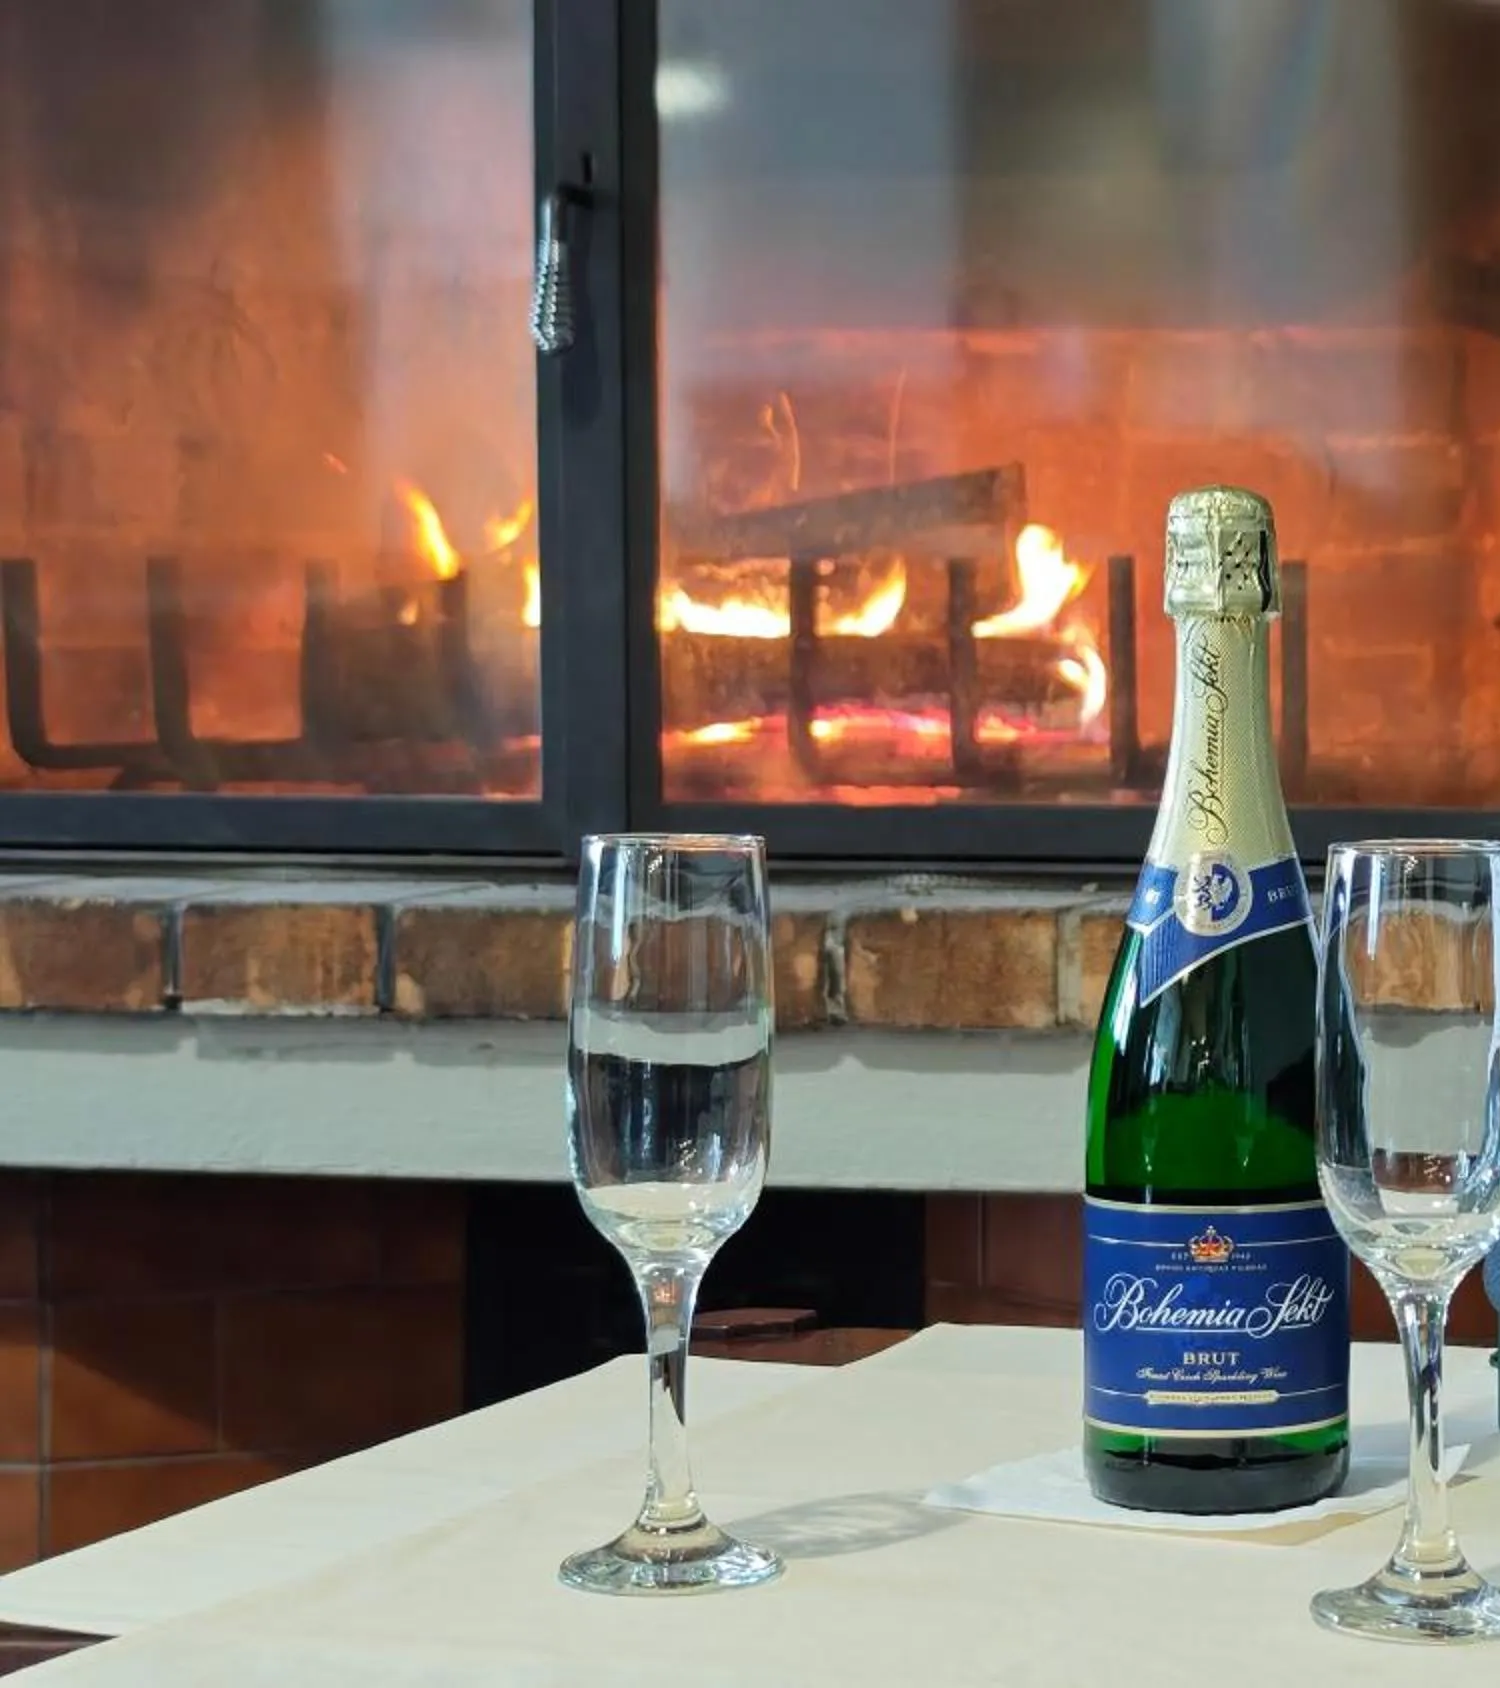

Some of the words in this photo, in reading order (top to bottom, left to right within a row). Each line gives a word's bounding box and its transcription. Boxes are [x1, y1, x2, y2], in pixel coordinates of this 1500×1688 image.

[1188, 634, 1229, 714] Sekt
[1184, 702, 1230, 847] Bohemia
[1093, 1272, 1247, 1332] Bohemia
[1245, 1273, 1336, 1340] Sekt
[1183, 1351, 1240, 1366] BRUT
